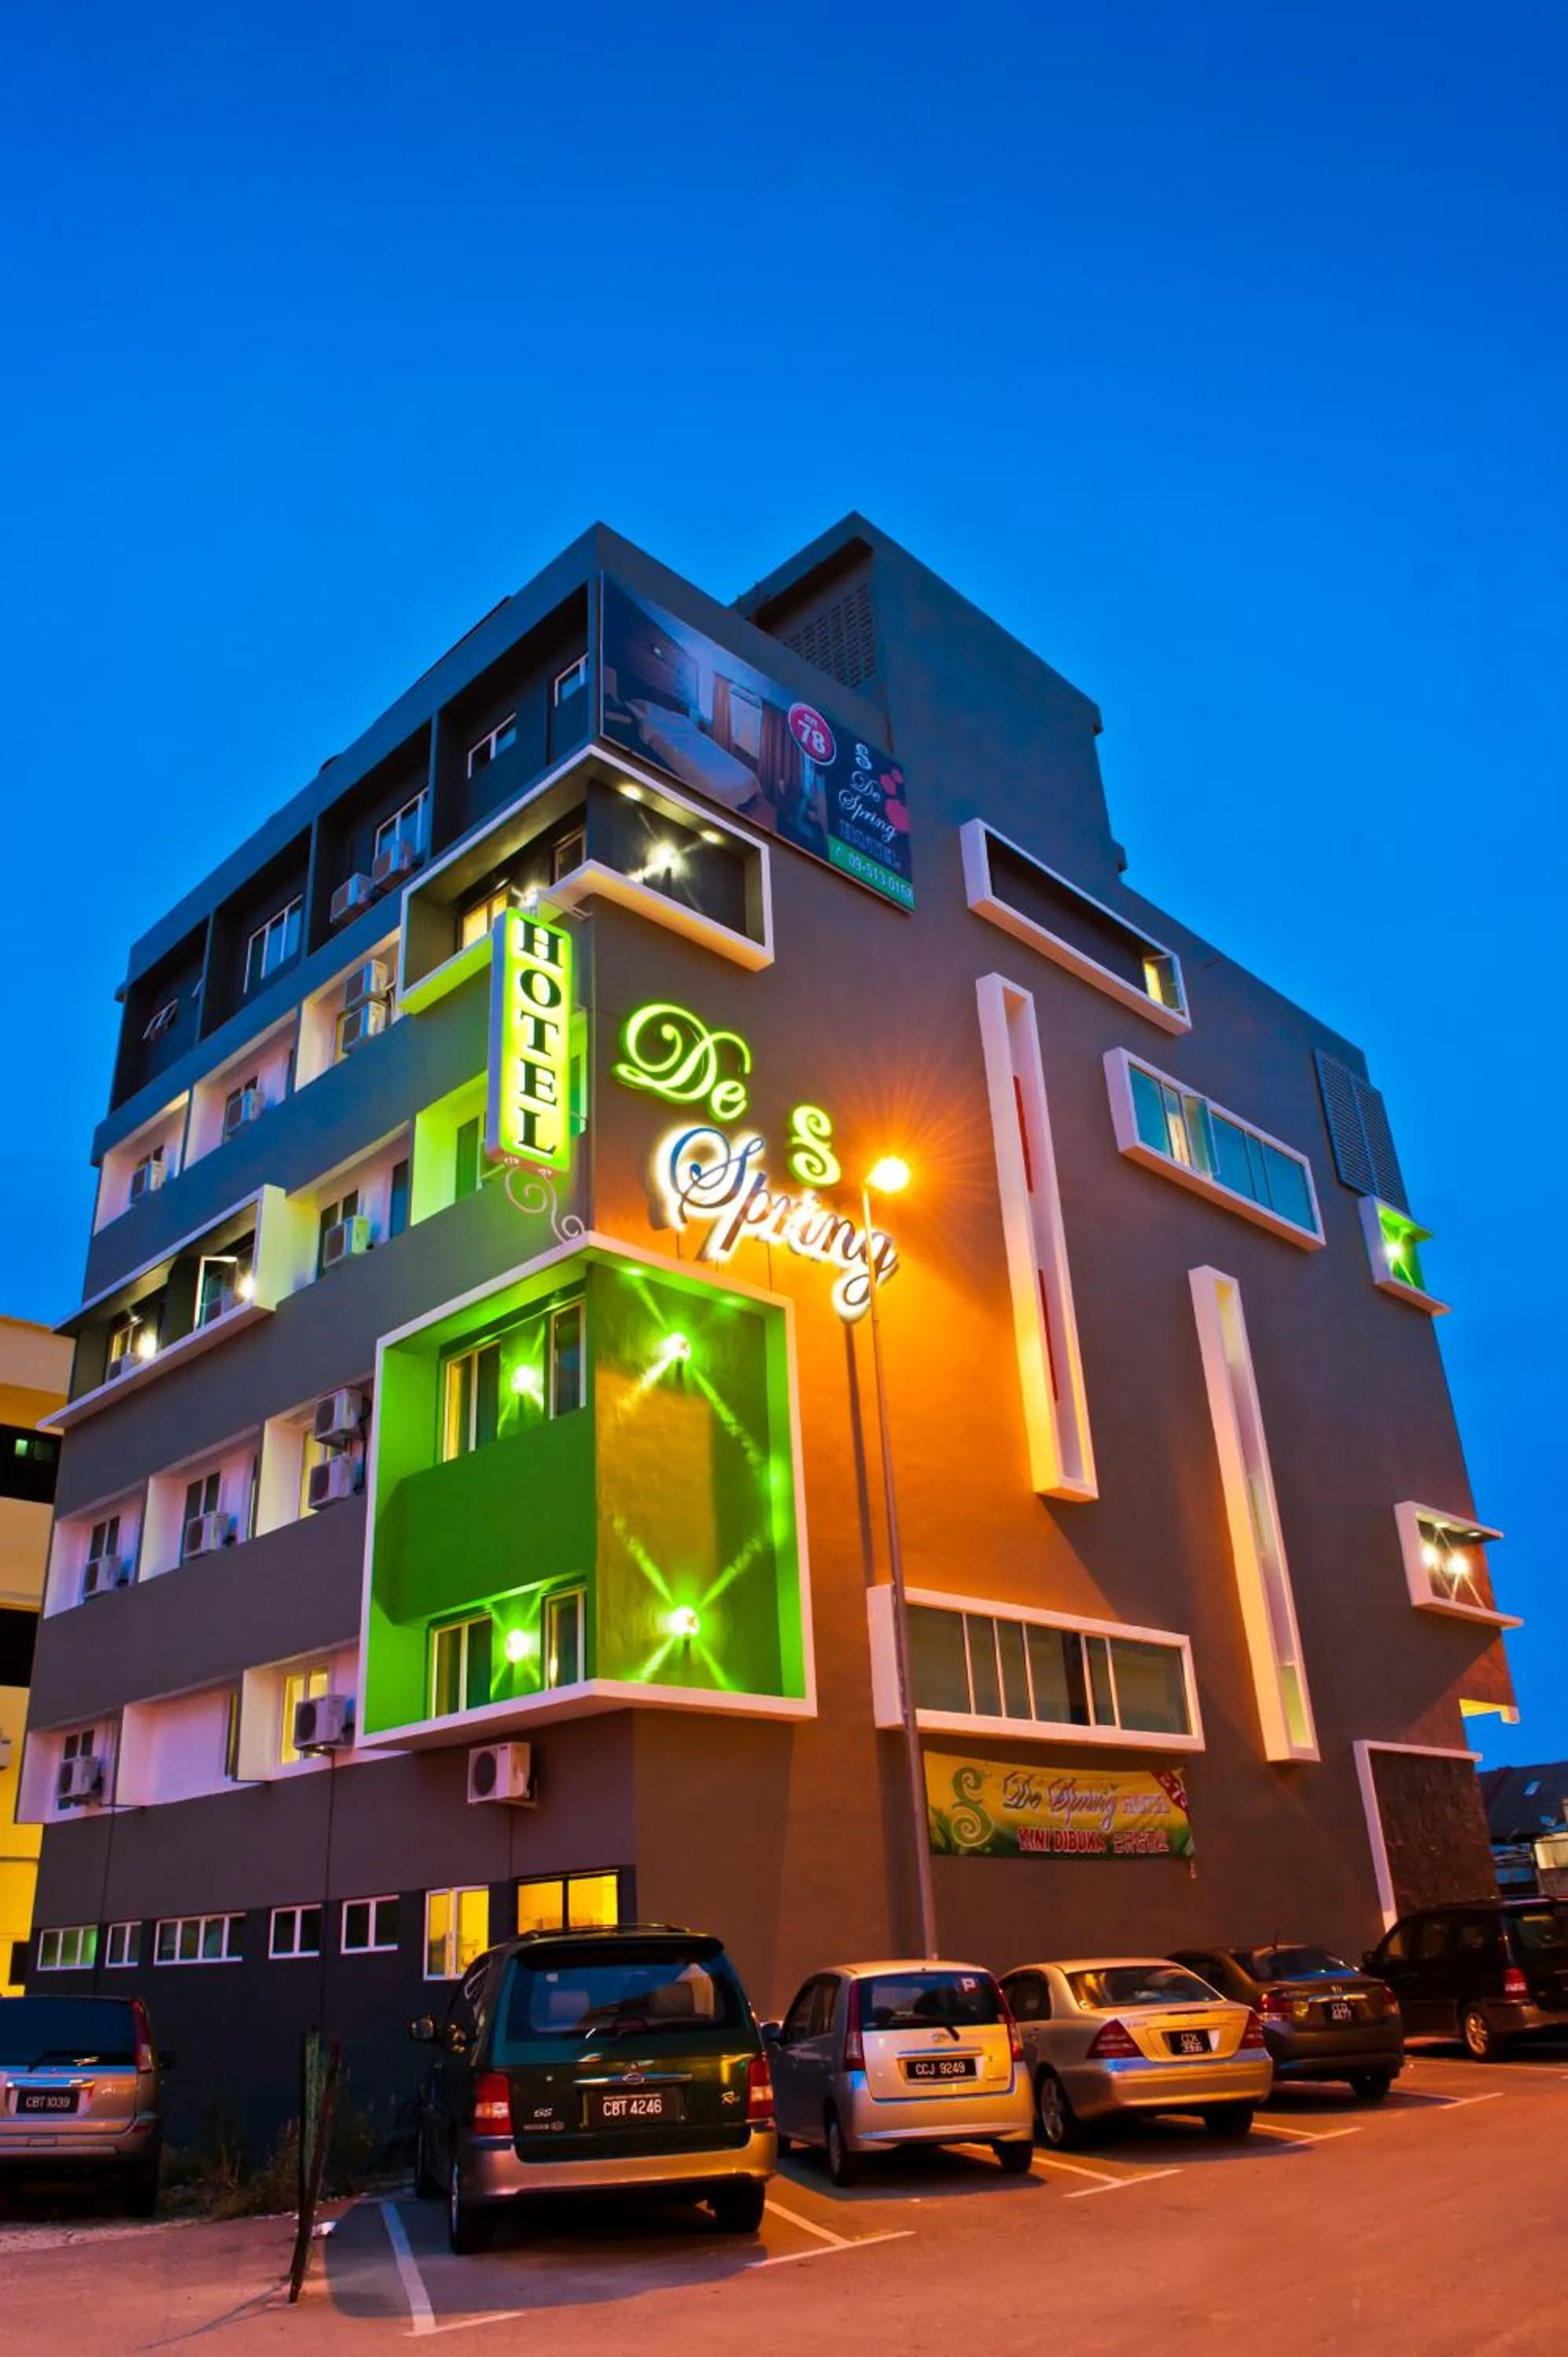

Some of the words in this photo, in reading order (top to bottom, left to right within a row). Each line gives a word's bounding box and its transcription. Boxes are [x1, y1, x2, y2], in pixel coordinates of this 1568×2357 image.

[797, 719, 826, 754] 78
[837, 789, 897, 844] Spring
[513, 915, 564, 1157] HOTEL
[613, 1003, 752, 1120] De
[665, 1125, 899, 1310] Spring
[26, 2095, 46, 2108] CBT
[46, 2095, 71, 2108] 1039
[603, 2100, 628, 2117] CBT
[629, 2099, 662, 2115] 4246
